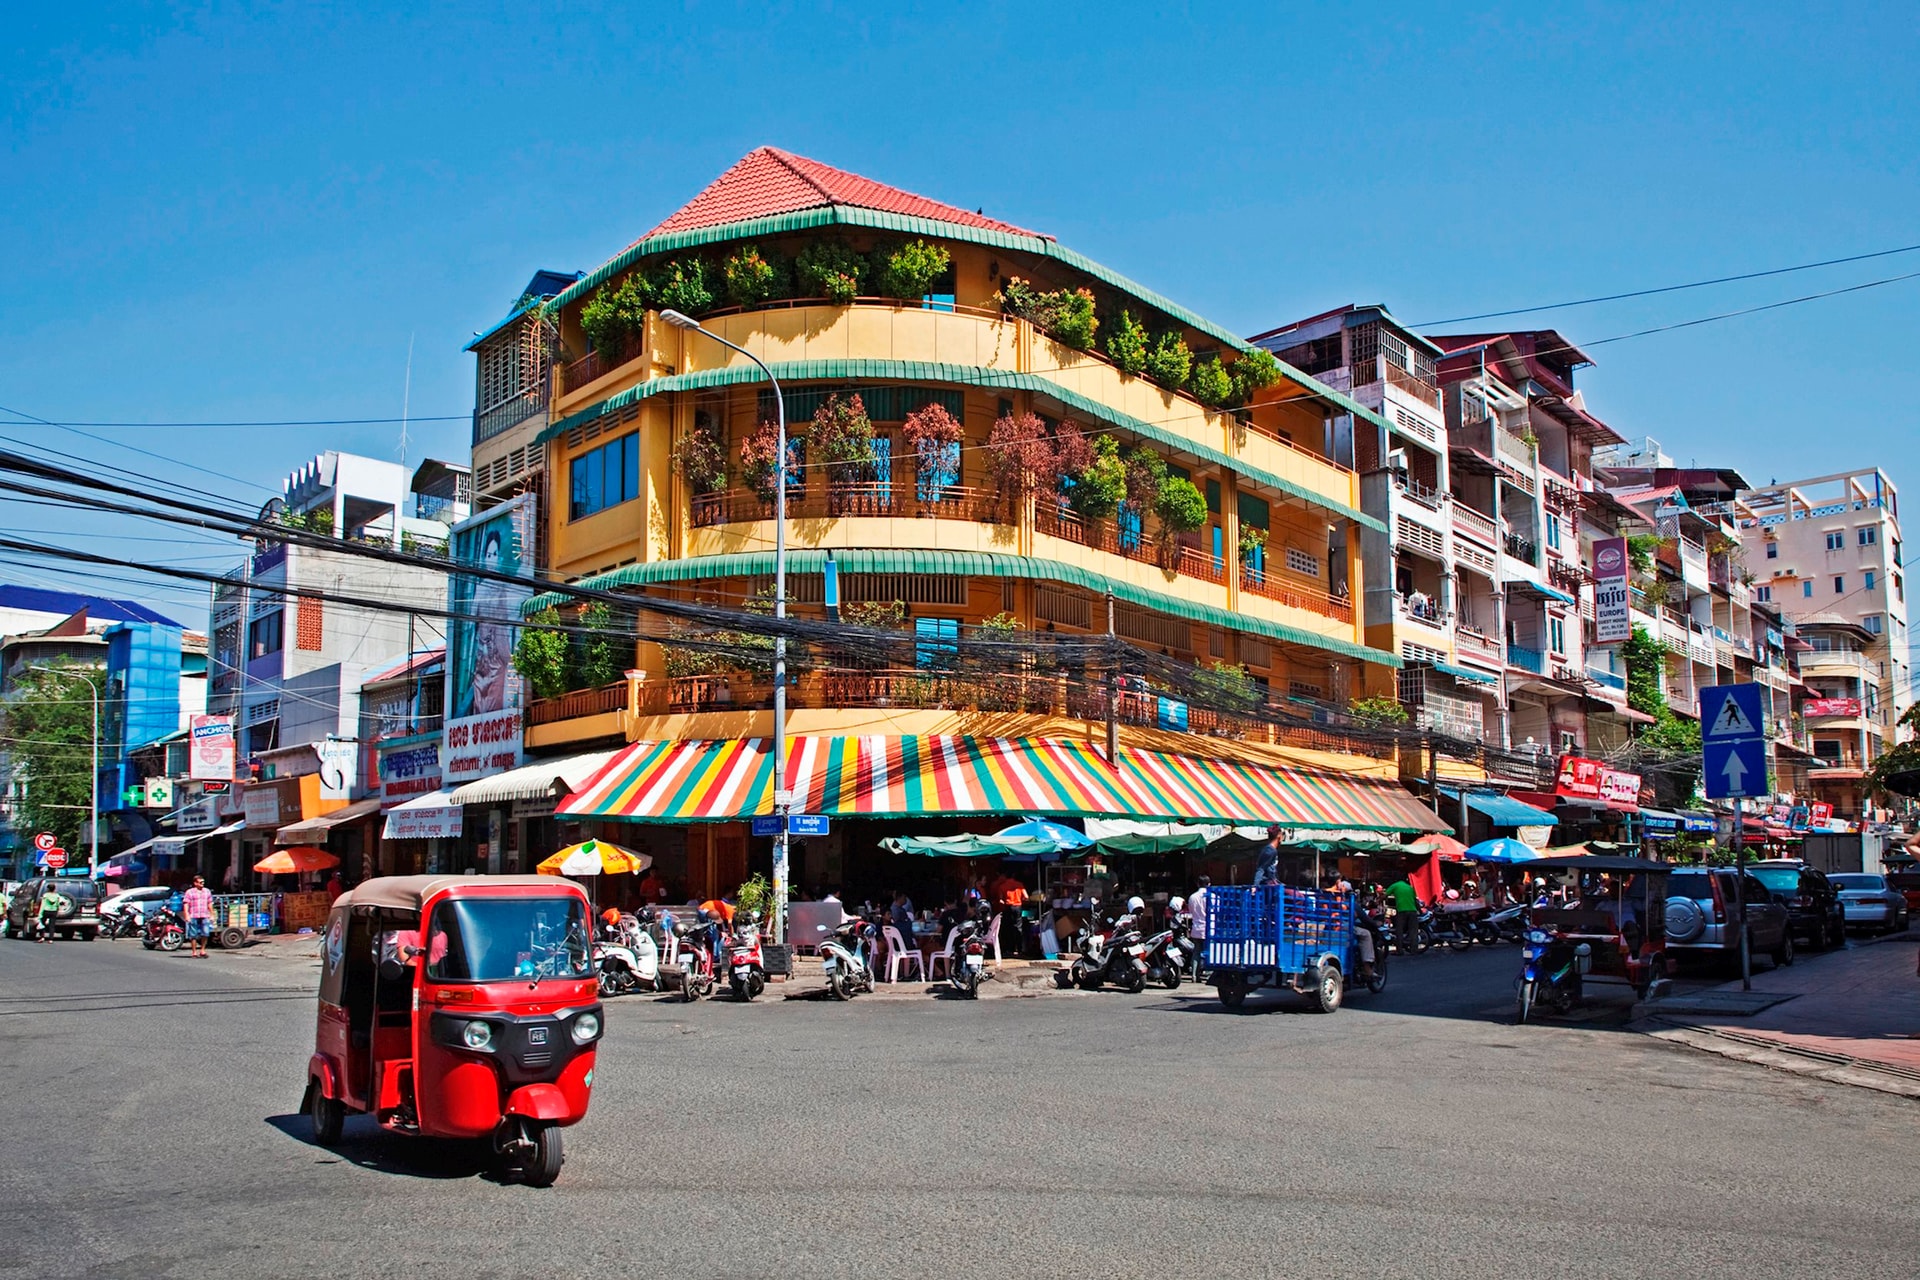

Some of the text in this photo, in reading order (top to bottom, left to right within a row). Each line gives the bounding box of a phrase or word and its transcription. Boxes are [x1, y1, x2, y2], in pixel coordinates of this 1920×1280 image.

[1599, 608, 1625, 618] EUROPE
[196, 725, 232, 737] ANCHOR
[532, 1032, 545, 1042] RE
